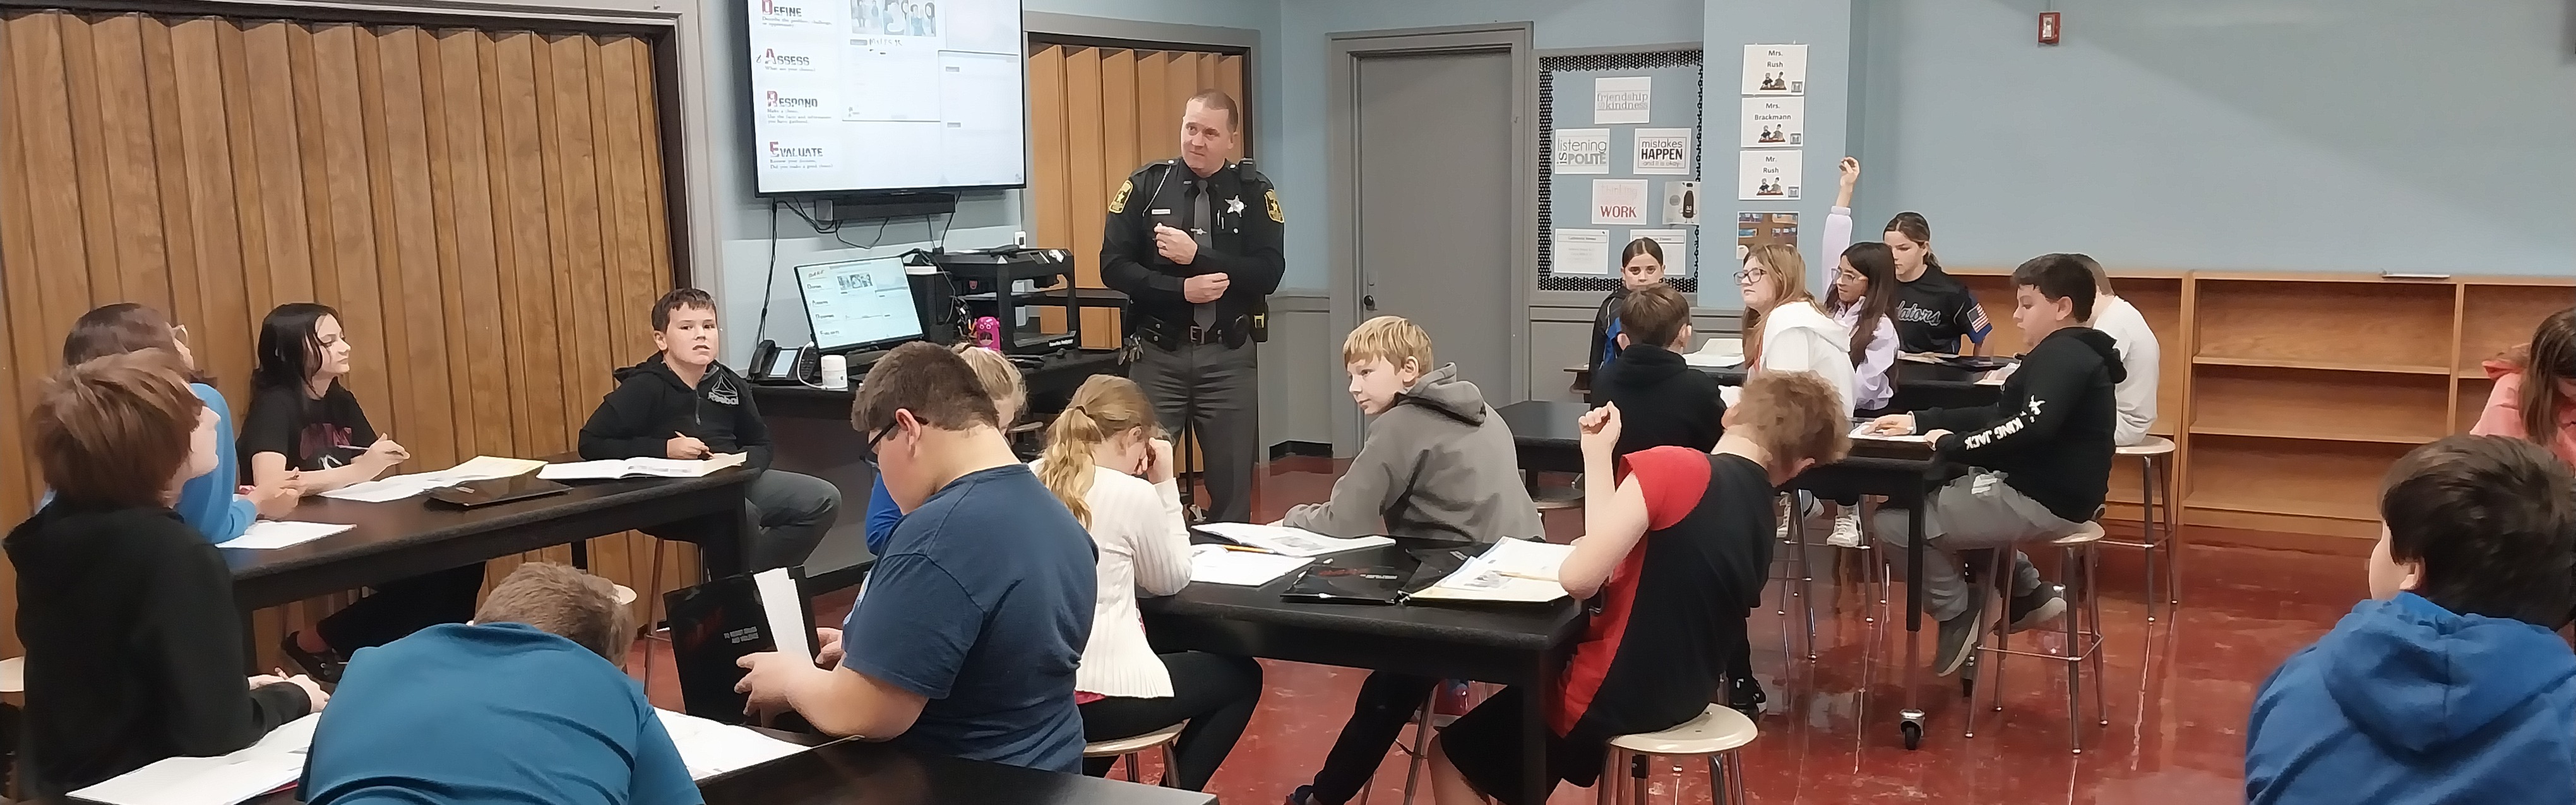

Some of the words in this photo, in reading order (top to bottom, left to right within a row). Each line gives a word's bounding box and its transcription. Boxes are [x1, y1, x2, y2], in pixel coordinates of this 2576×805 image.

[765, 48, 809, 66] ASSESS
[766, 90, 818, 108] RESPOND
[1597, 93, 1649, 102] friendship
[1605, 101, 1649, 110] kindness
[770, 141, 823, 158] EVALUATE
[1558, 138, 1607, 154] listening
[1642, 138, 1683, 148] mistakes
[1556, 152, 1567, 164] is
[1568, 153, 1606, 165] POLITE
[1641, 148, 1683, 160] HAPPEN
[1600, 205, 1637, 218] WORK
[1994, 417, 2024, 440] KING
[1964, 430, 1993, 450] JACK
